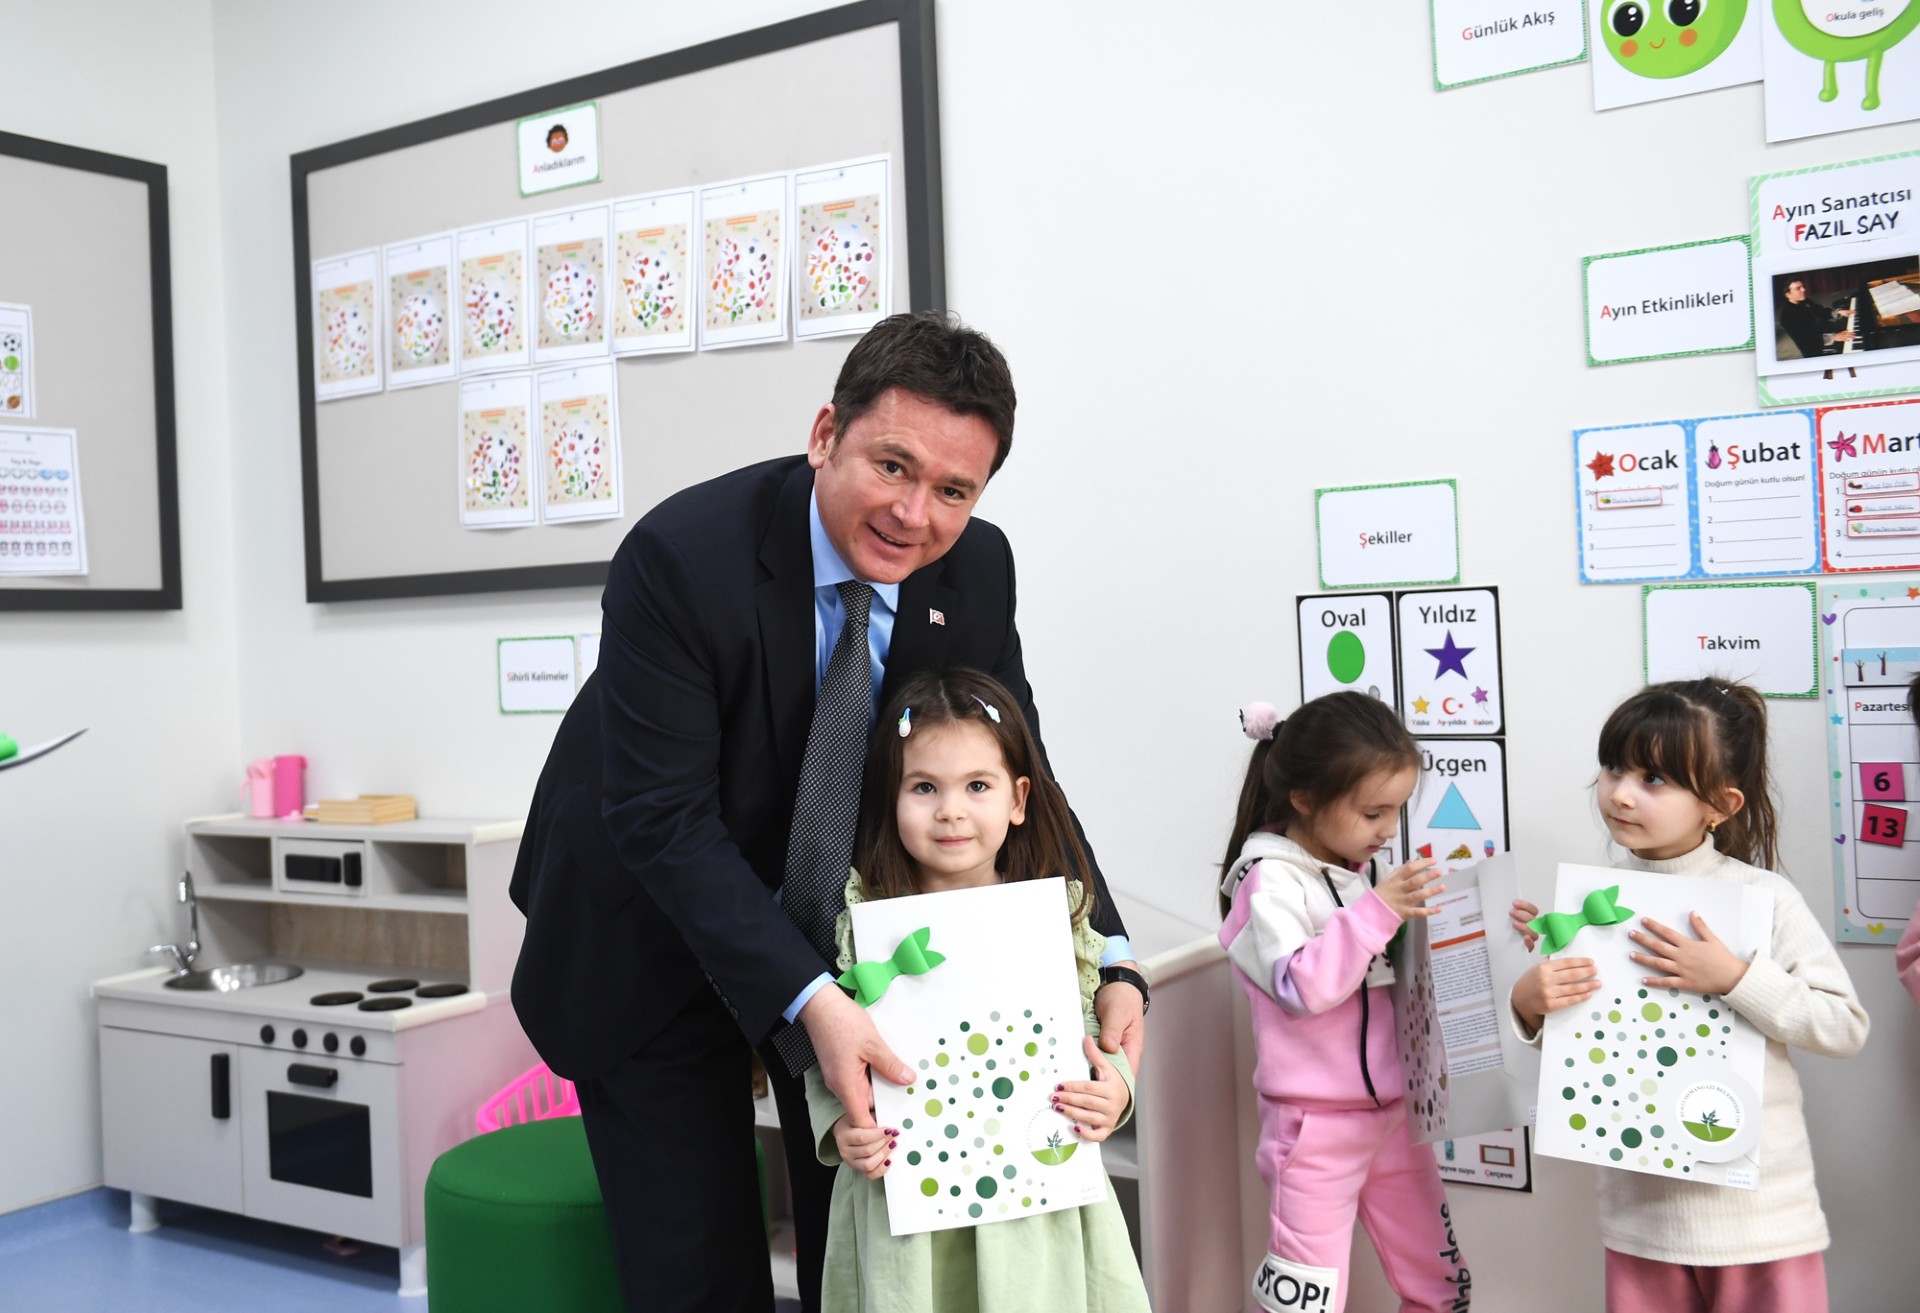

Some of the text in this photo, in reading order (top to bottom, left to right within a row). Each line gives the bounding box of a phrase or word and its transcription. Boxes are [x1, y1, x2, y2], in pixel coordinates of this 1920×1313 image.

[1826, 8, 1884, 22] Okula geliş
[1462, 11, 1555, 41] Günlük Akış
[533, 155, 586, 173] Anladıklarım
[1772, 203, 1815, 222] Ayın
[1794, 211, 1899, 242] FAZIL SAY
[1600, 290, 1734, 321] Ayın Etkinlikleri
[1619, 450, 1679, 473] Ocak
[1727, 441, 1801, 470] Şubat
[1705, 474, 1805, 488] Doğum günün kutlu olsun!
[1359, 530, 1412, 549] Şekiller
[1321, 608, 1366, 628] Oval
[1419, 604, 1477, 624] Yıldız
[1697, 635, 1760, 650] Takvim
[507, 671, 569, 683] Sihirli Kelimeler
[1420, 749, 1487, 777] Üçgen
[1874, 771, 1891, 792] 6
[1868, 816, 1899, 838] 13
[1258, 1262, 1331, 1313] STOP!
